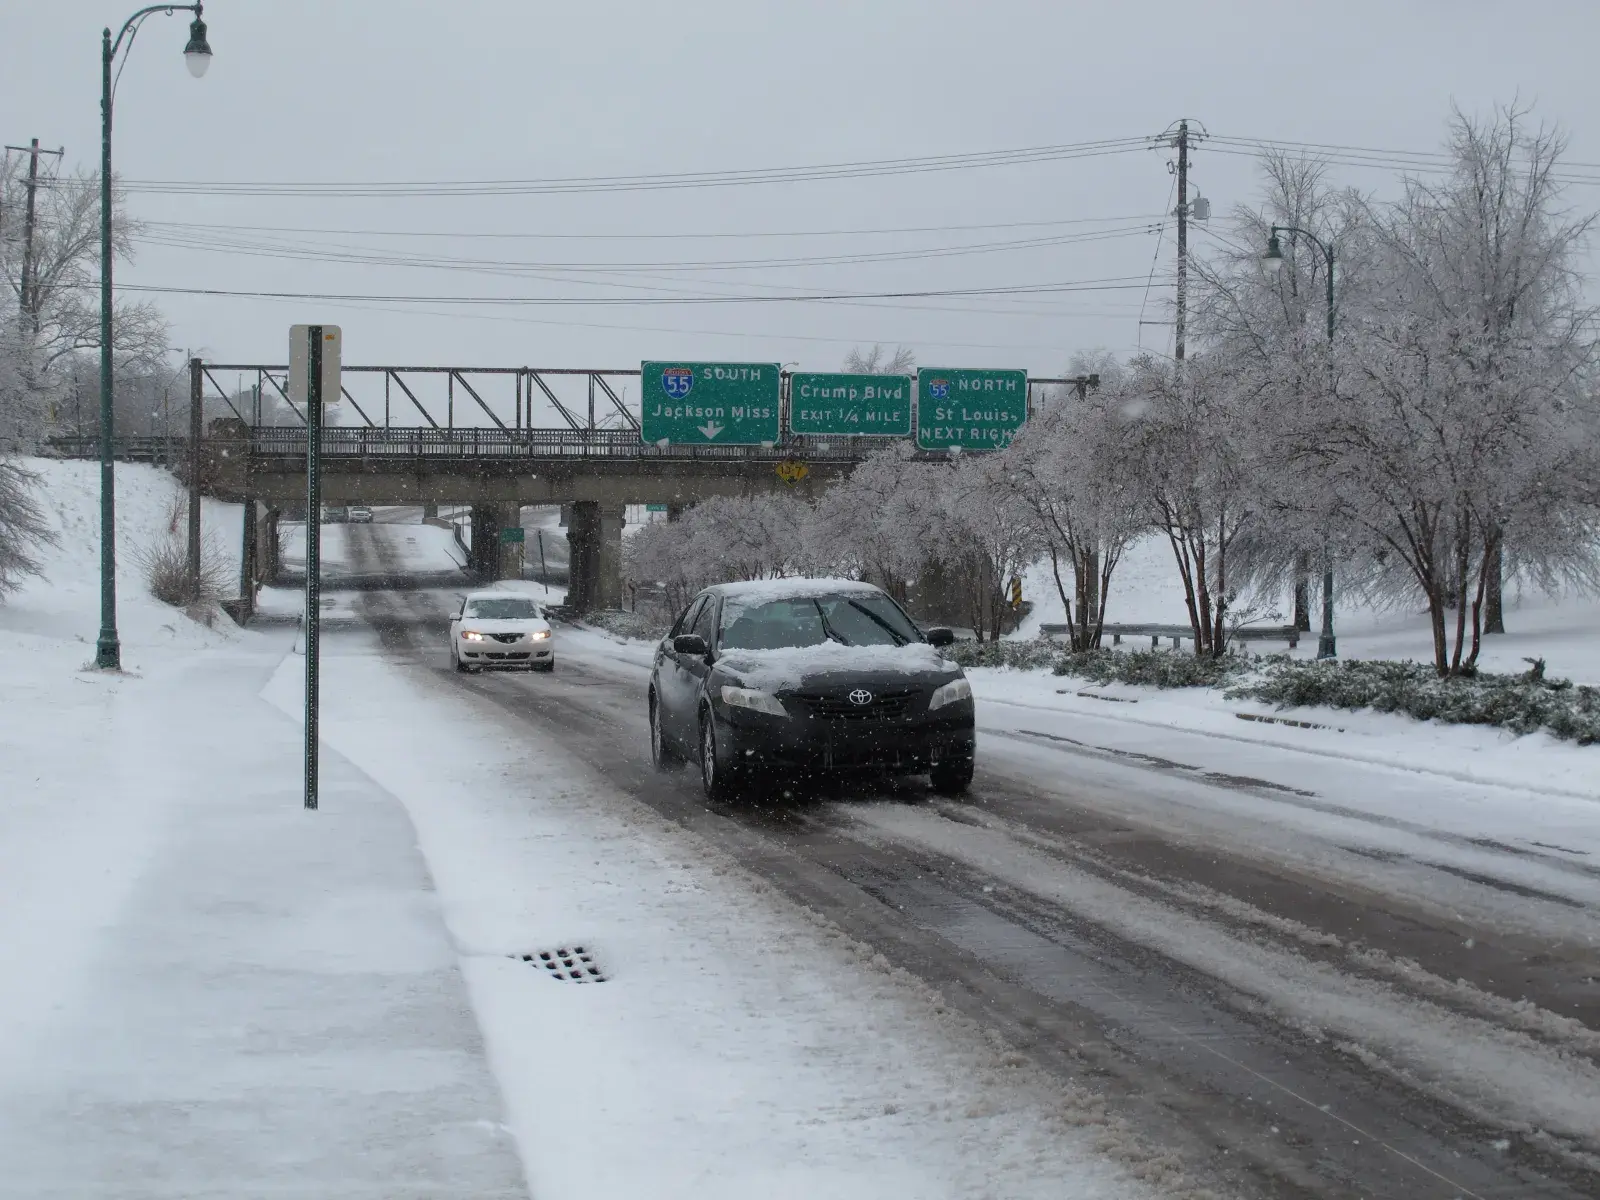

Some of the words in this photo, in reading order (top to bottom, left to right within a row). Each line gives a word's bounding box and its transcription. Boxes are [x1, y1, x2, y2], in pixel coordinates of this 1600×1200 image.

[703, 367, 761, 381] SOUTH
[667, 376, 690, 394] 55
[800, 384, 858, 400] Crump
[865, 386, 902, 399] Blvd
[932, 384, 948, 397] 55
[959, 379, 1016, 391] NORTH
[651, 403, 725, 418] Jackson
[801, 410, 832, 420] EXIT
[866, 411, 901, 422] MILE
[935, 407, 954, 421] St
[921, 427, 965, 440] NEXT
